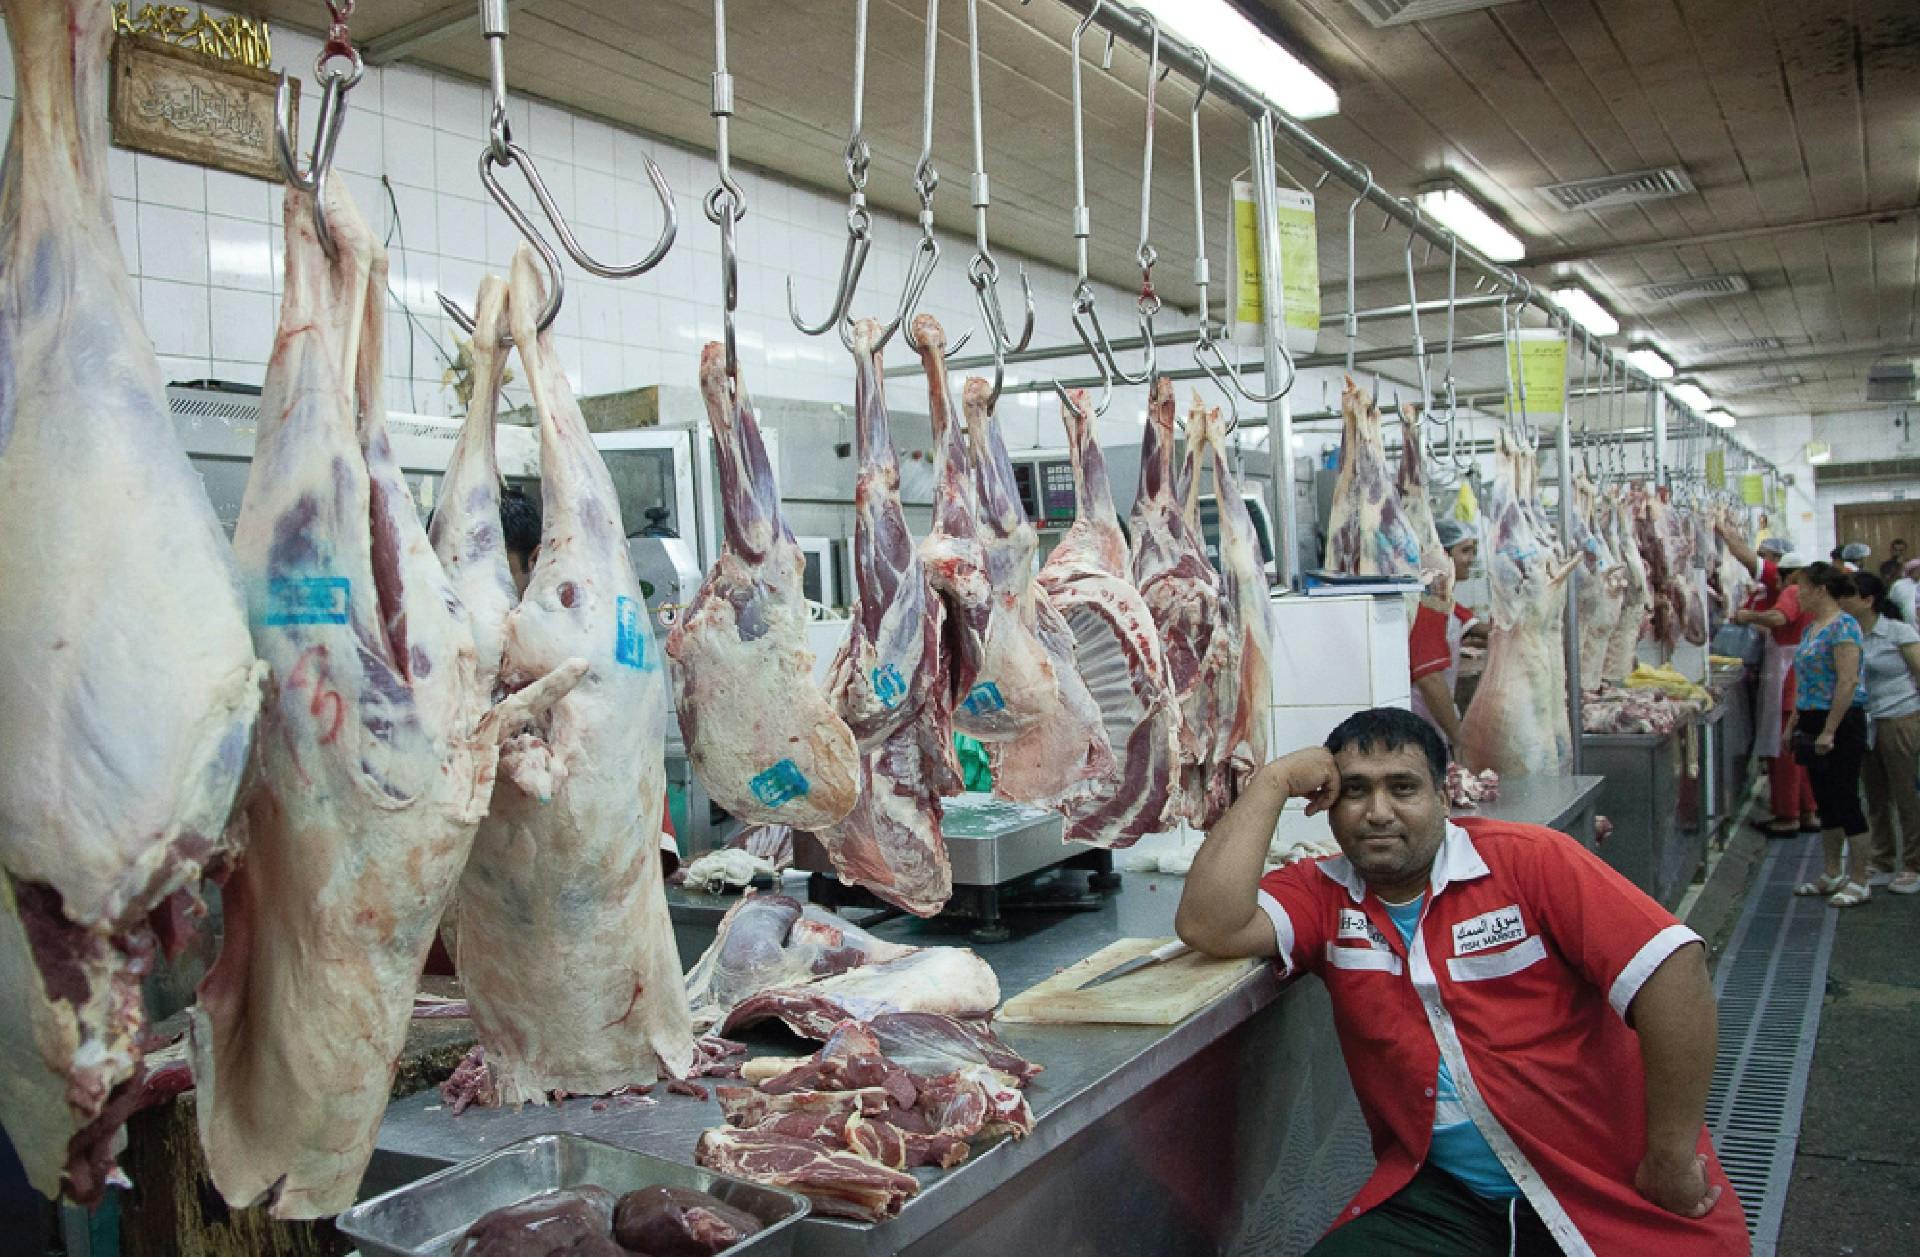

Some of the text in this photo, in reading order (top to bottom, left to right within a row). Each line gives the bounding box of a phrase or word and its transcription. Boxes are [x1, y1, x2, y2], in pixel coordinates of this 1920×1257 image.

[1491, 915, 1520, 934] سوق
[1461, 929, 1522, 953] FISH MARKET
